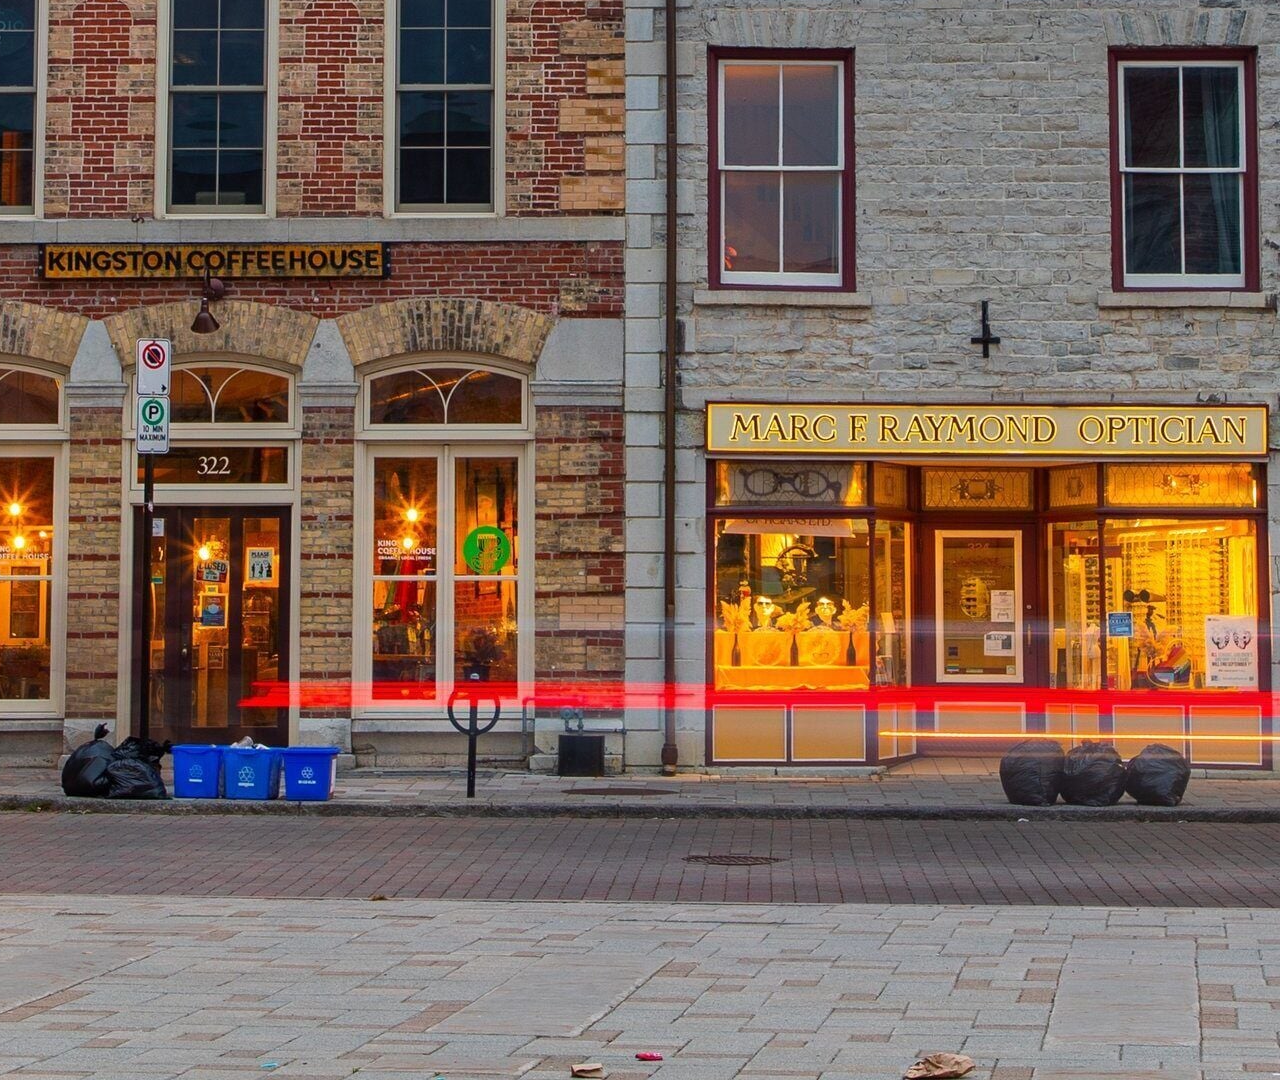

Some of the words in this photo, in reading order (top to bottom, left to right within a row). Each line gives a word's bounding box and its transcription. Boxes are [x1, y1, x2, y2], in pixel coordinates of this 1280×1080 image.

[47, 250, 182, 271] KINGSTON
[140, 433, 166, 441] MAXIMUM
[152, 425, 163, 433] MIN
[728, 413, 837, 443] MARC
[878, 413, 1058, 445] RAYMOND
[1077, 414, 1248, 445] OPTICIAN
[197, 456, 231, 475] 322
